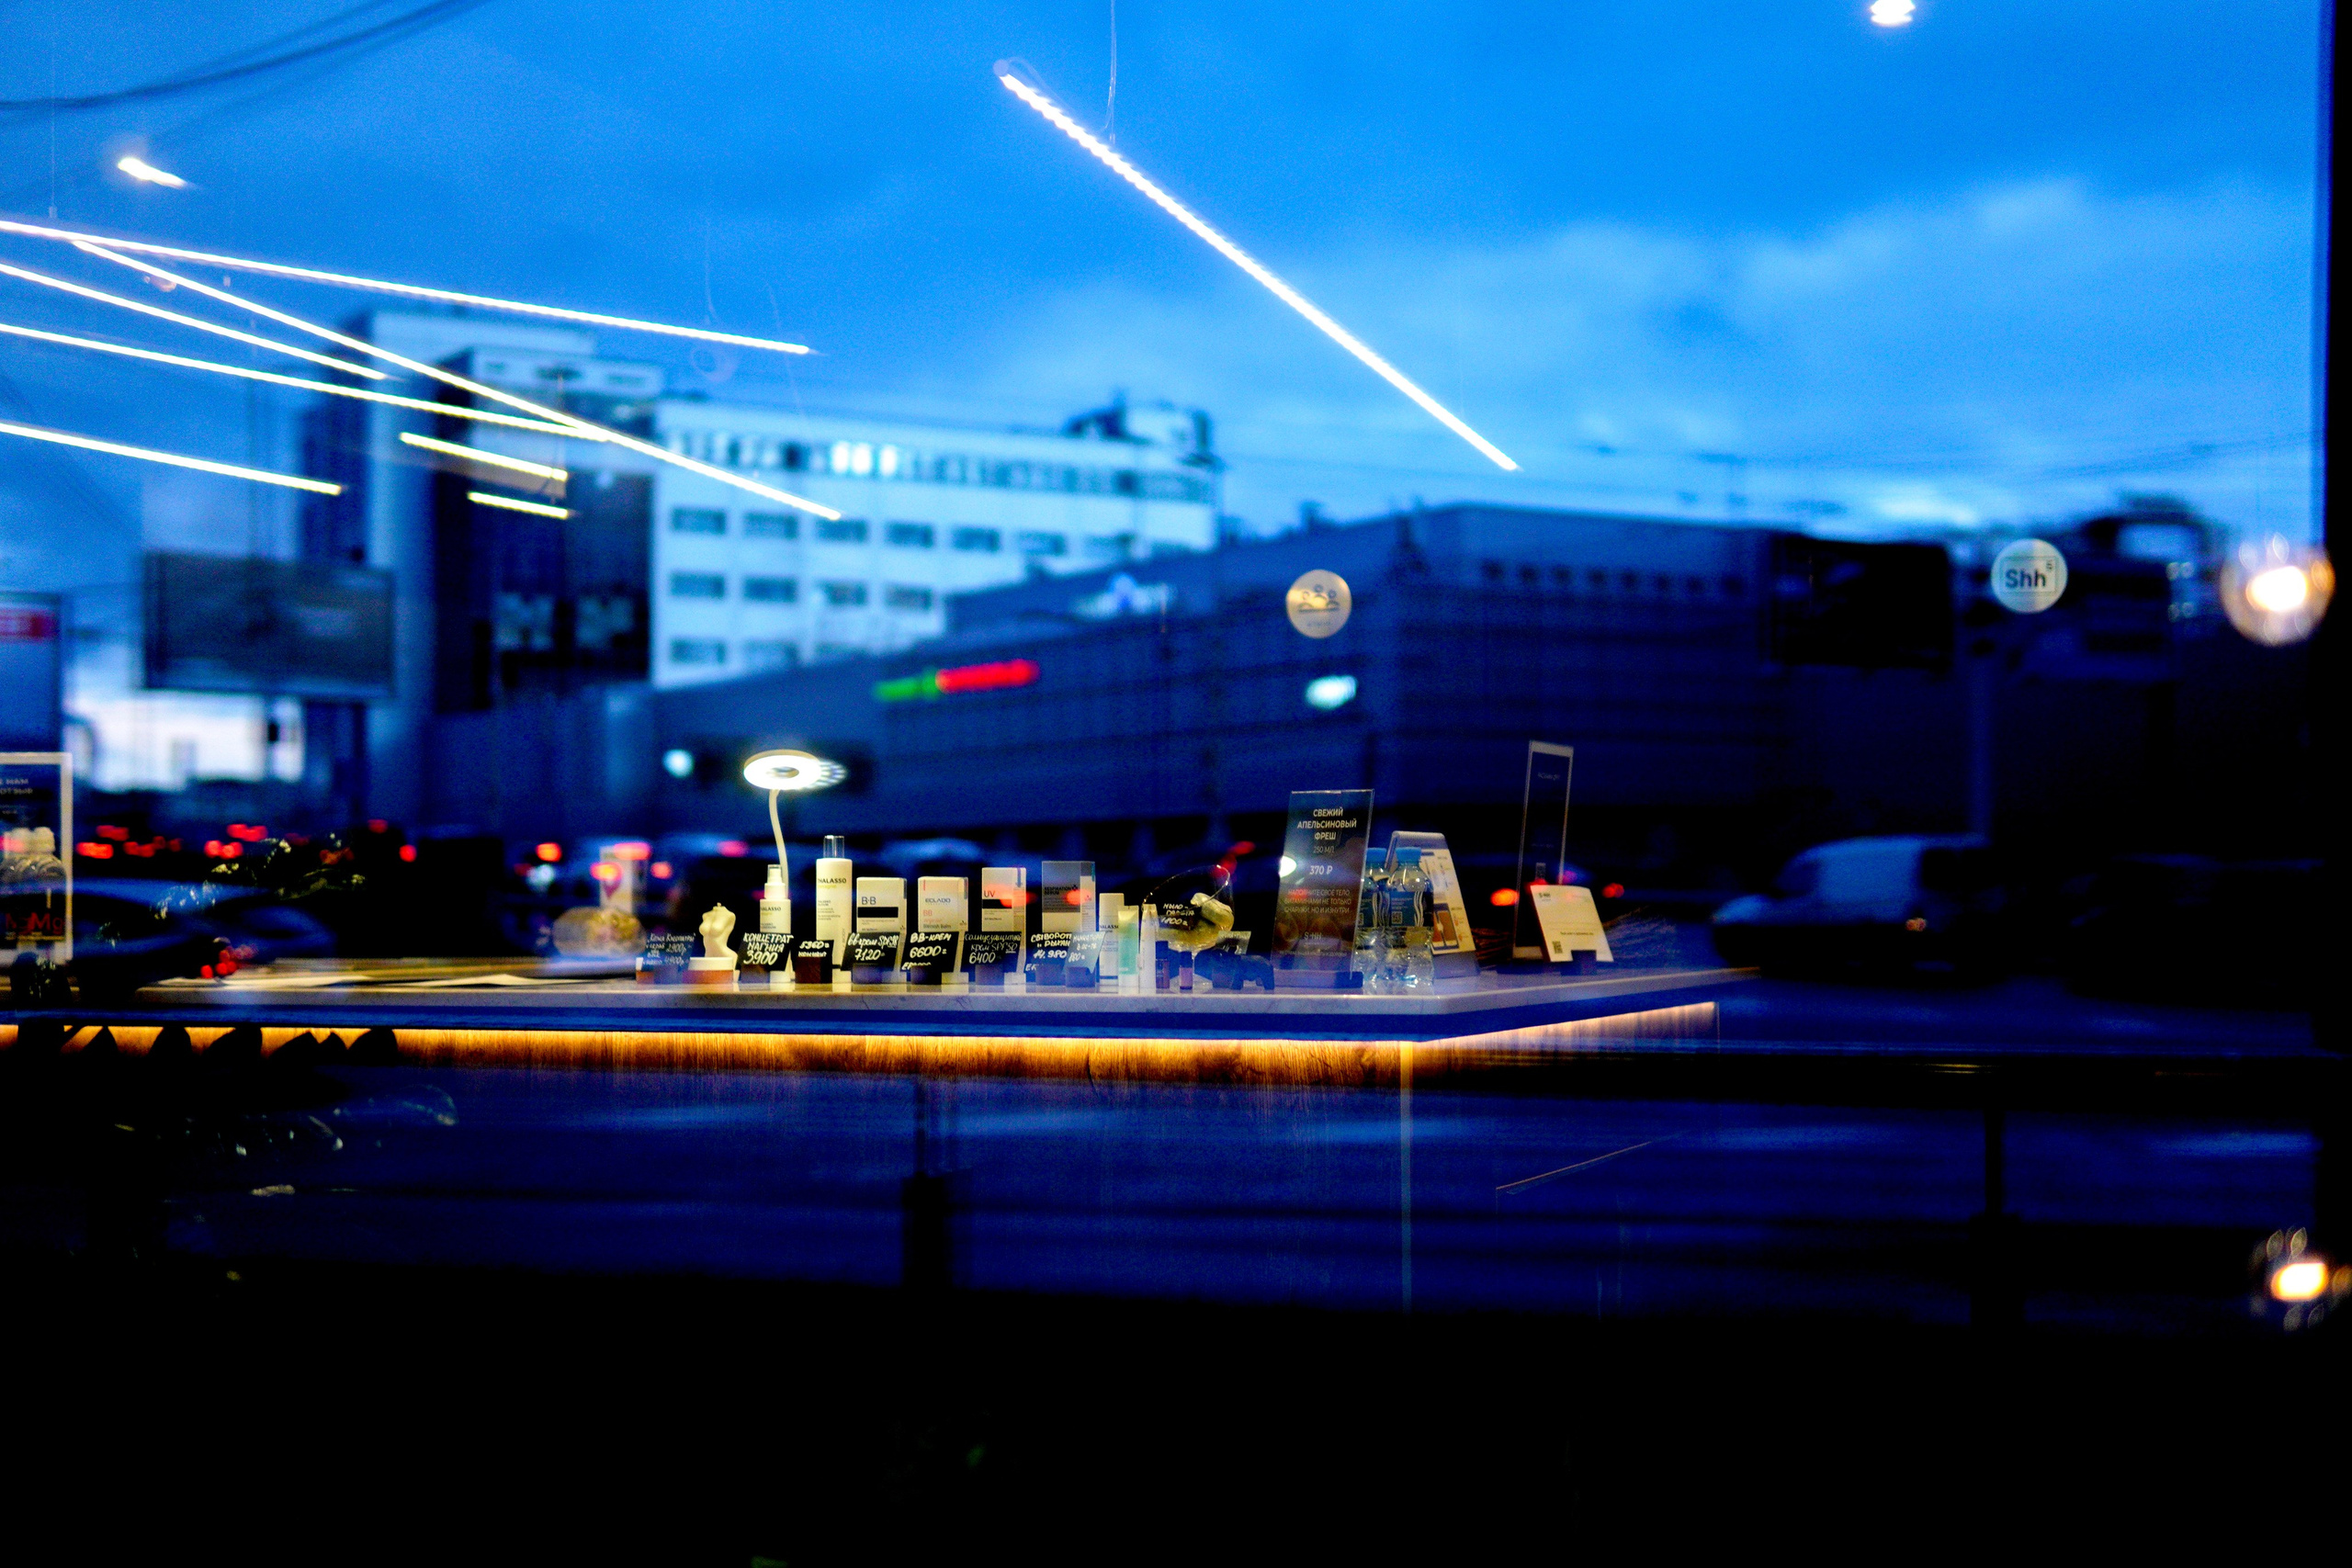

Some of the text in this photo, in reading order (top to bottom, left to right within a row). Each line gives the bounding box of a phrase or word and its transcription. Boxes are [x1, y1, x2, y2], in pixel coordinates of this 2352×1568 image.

[2006, 569, 2046, 588] Shh
[1313, 807, 1343, 817] СВЕЖИЙ
[1297, 818, 1357, 829] АПЕЛЬСИНОВЫЙ
[1315, 831, 1336, 840] ФРЕШ
[1309, 865, 1324, 874] 370
[743, 950, 778, 965] 3900
[969, 952, 996, 964] 6400
